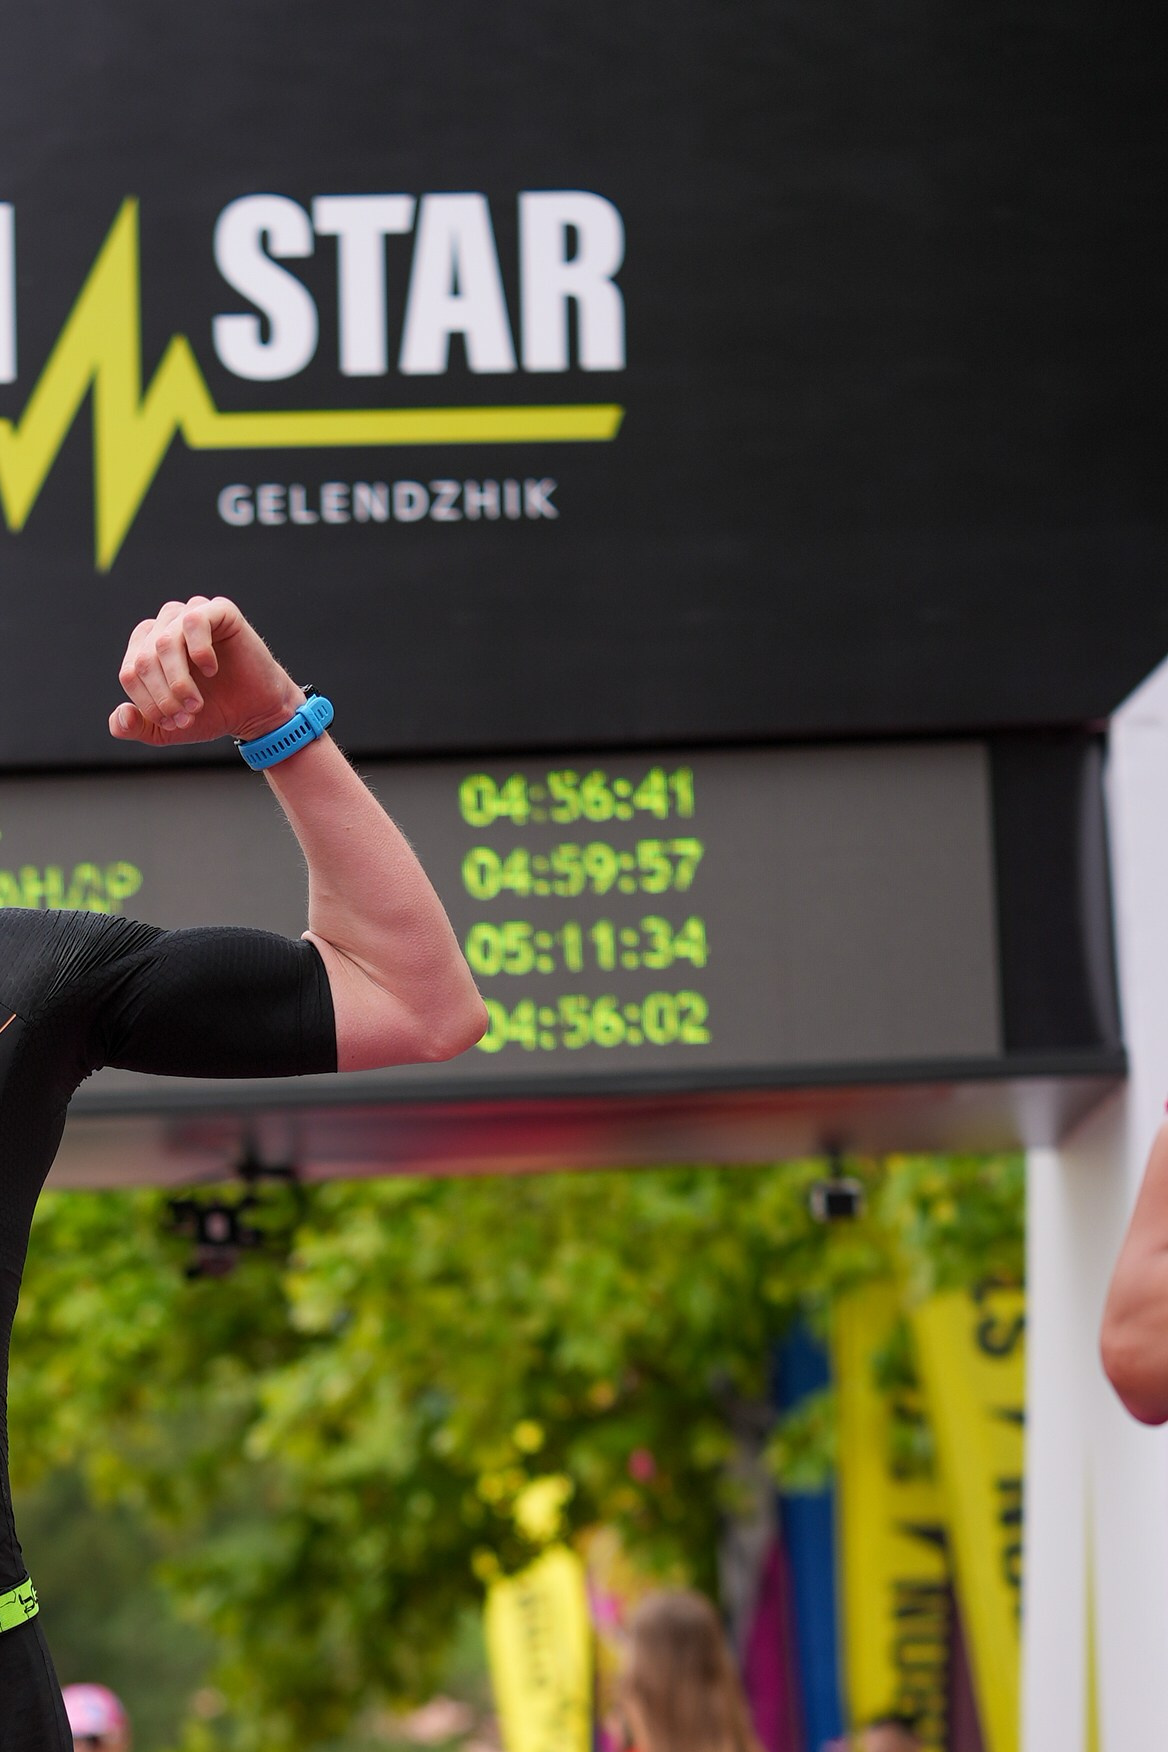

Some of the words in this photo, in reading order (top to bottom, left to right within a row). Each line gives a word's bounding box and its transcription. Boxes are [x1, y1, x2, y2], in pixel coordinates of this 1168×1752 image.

[213, 190, 625, 381] STAR
[217, 478, 559, 527] GELENDZHIK
[459, 767, 695, 827] 04:56:41
[462, 837, 704, 899] 04:59:57
[465, 915, 708, 976] 05:11:34
[477, 990, 710, 1053] 04:56:02
